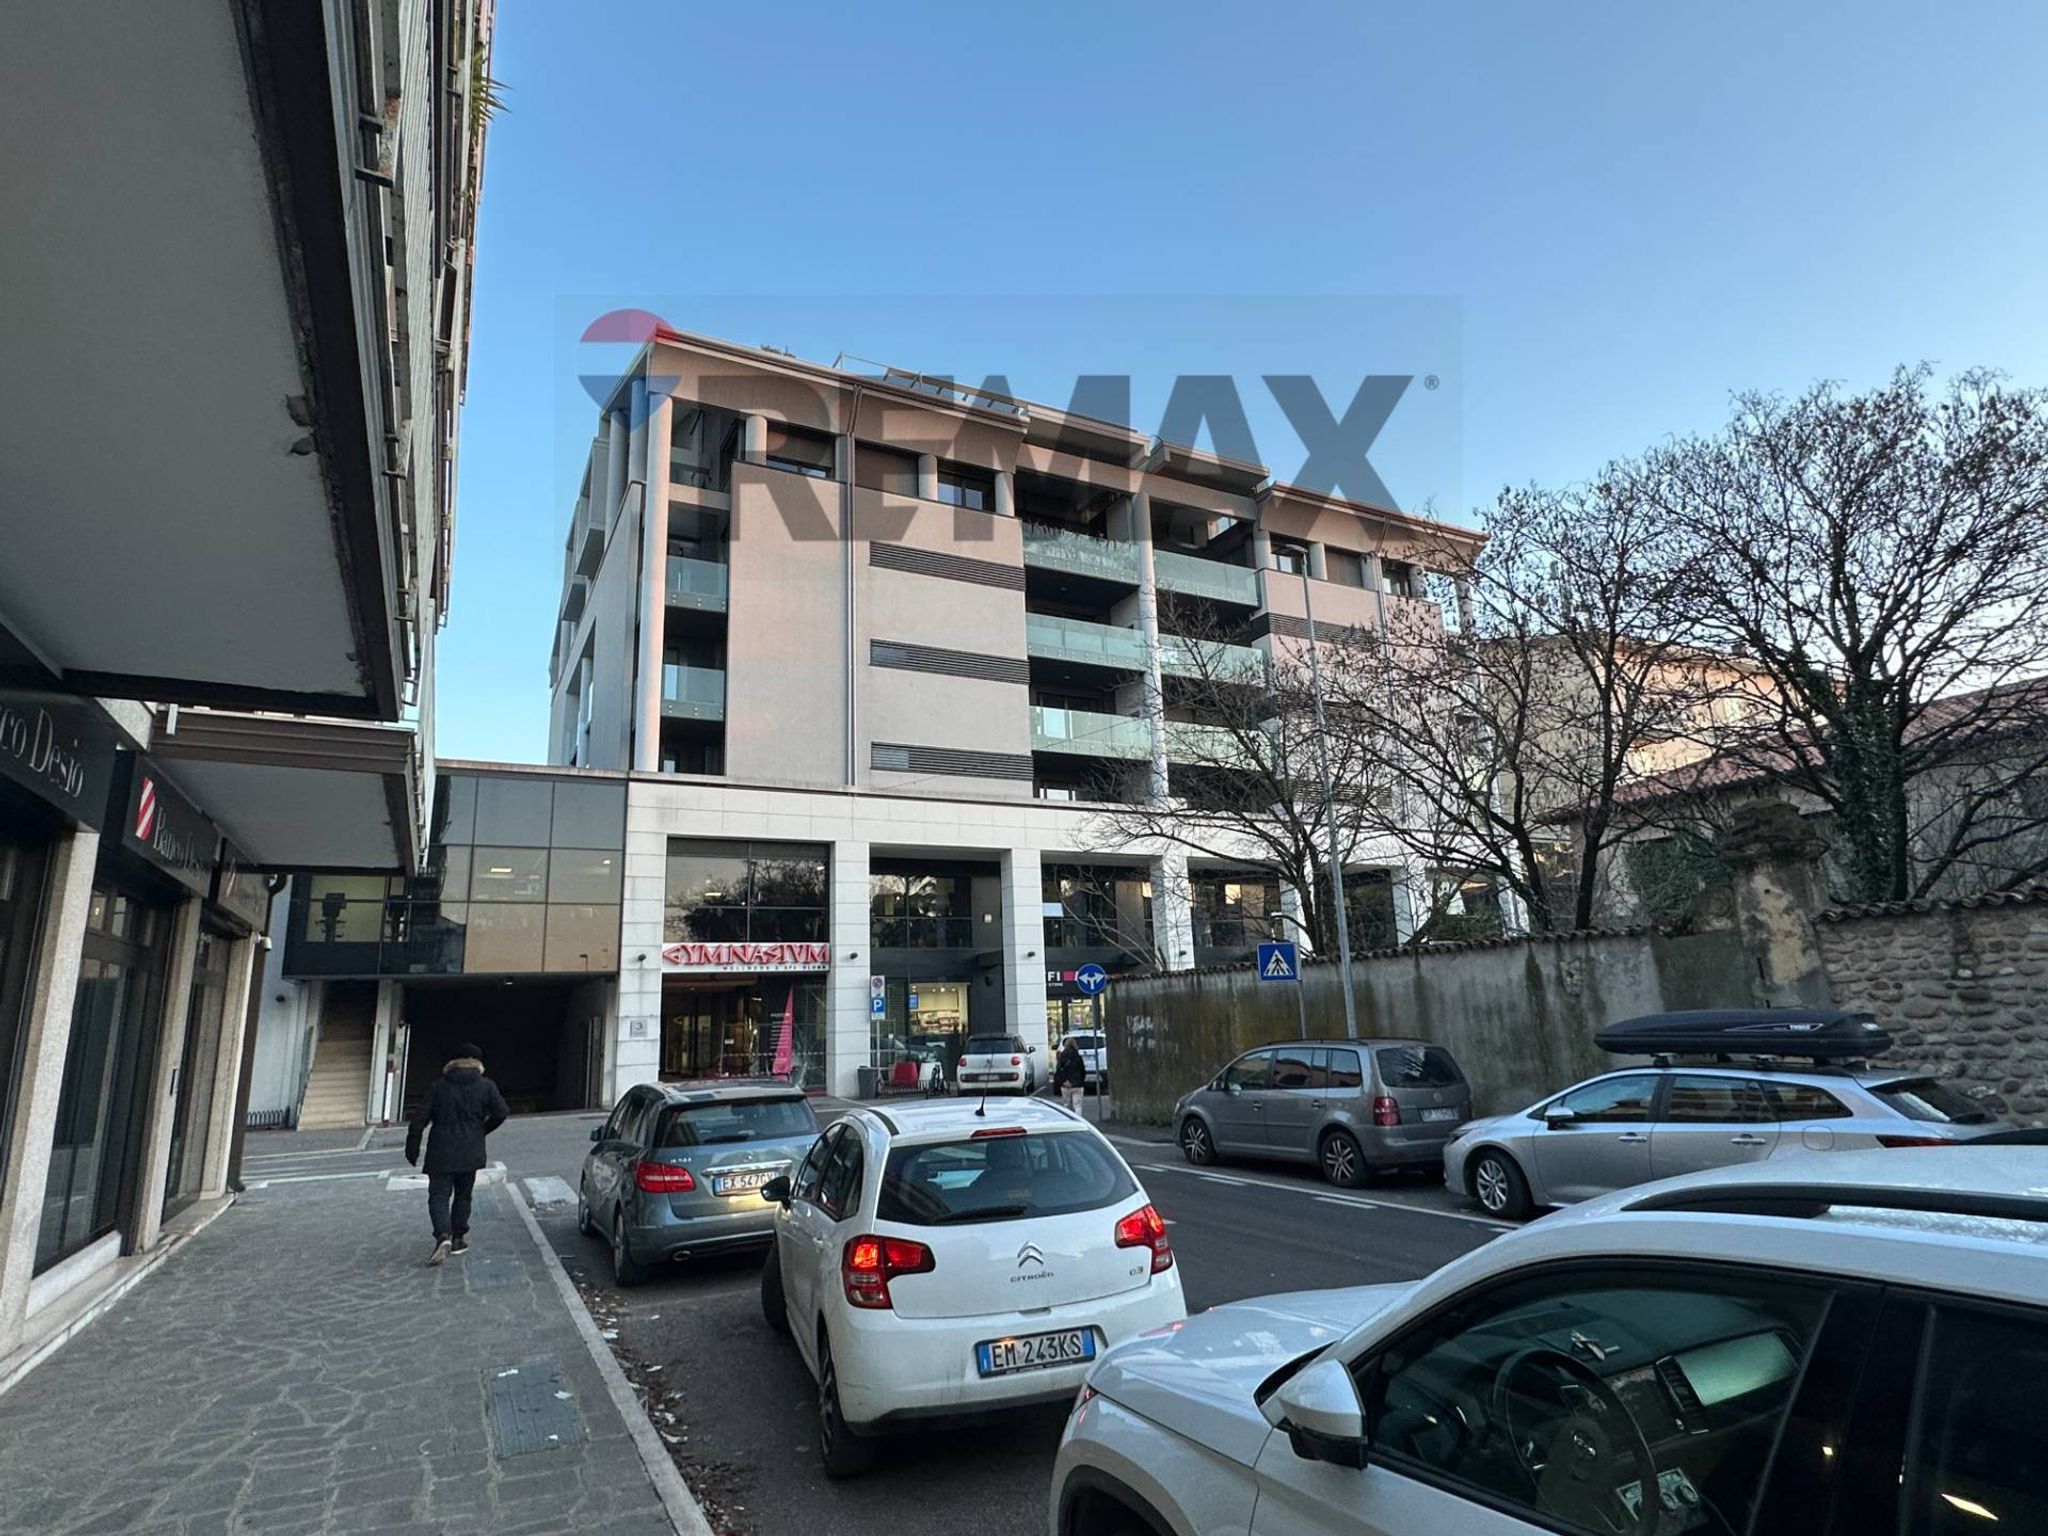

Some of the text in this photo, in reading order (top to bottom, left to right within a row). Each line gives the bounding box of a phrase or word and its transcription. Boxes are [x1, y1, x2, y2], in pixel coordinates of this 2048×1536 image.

[1047, 971, 1061, 982] FI
[873, 999, 883, 1012] P
[722, 1177, 736, 1191] EX
[1129, 1265, 1144, 1277] C3
[992, 1333, 1082, 1368] EM 243KS
